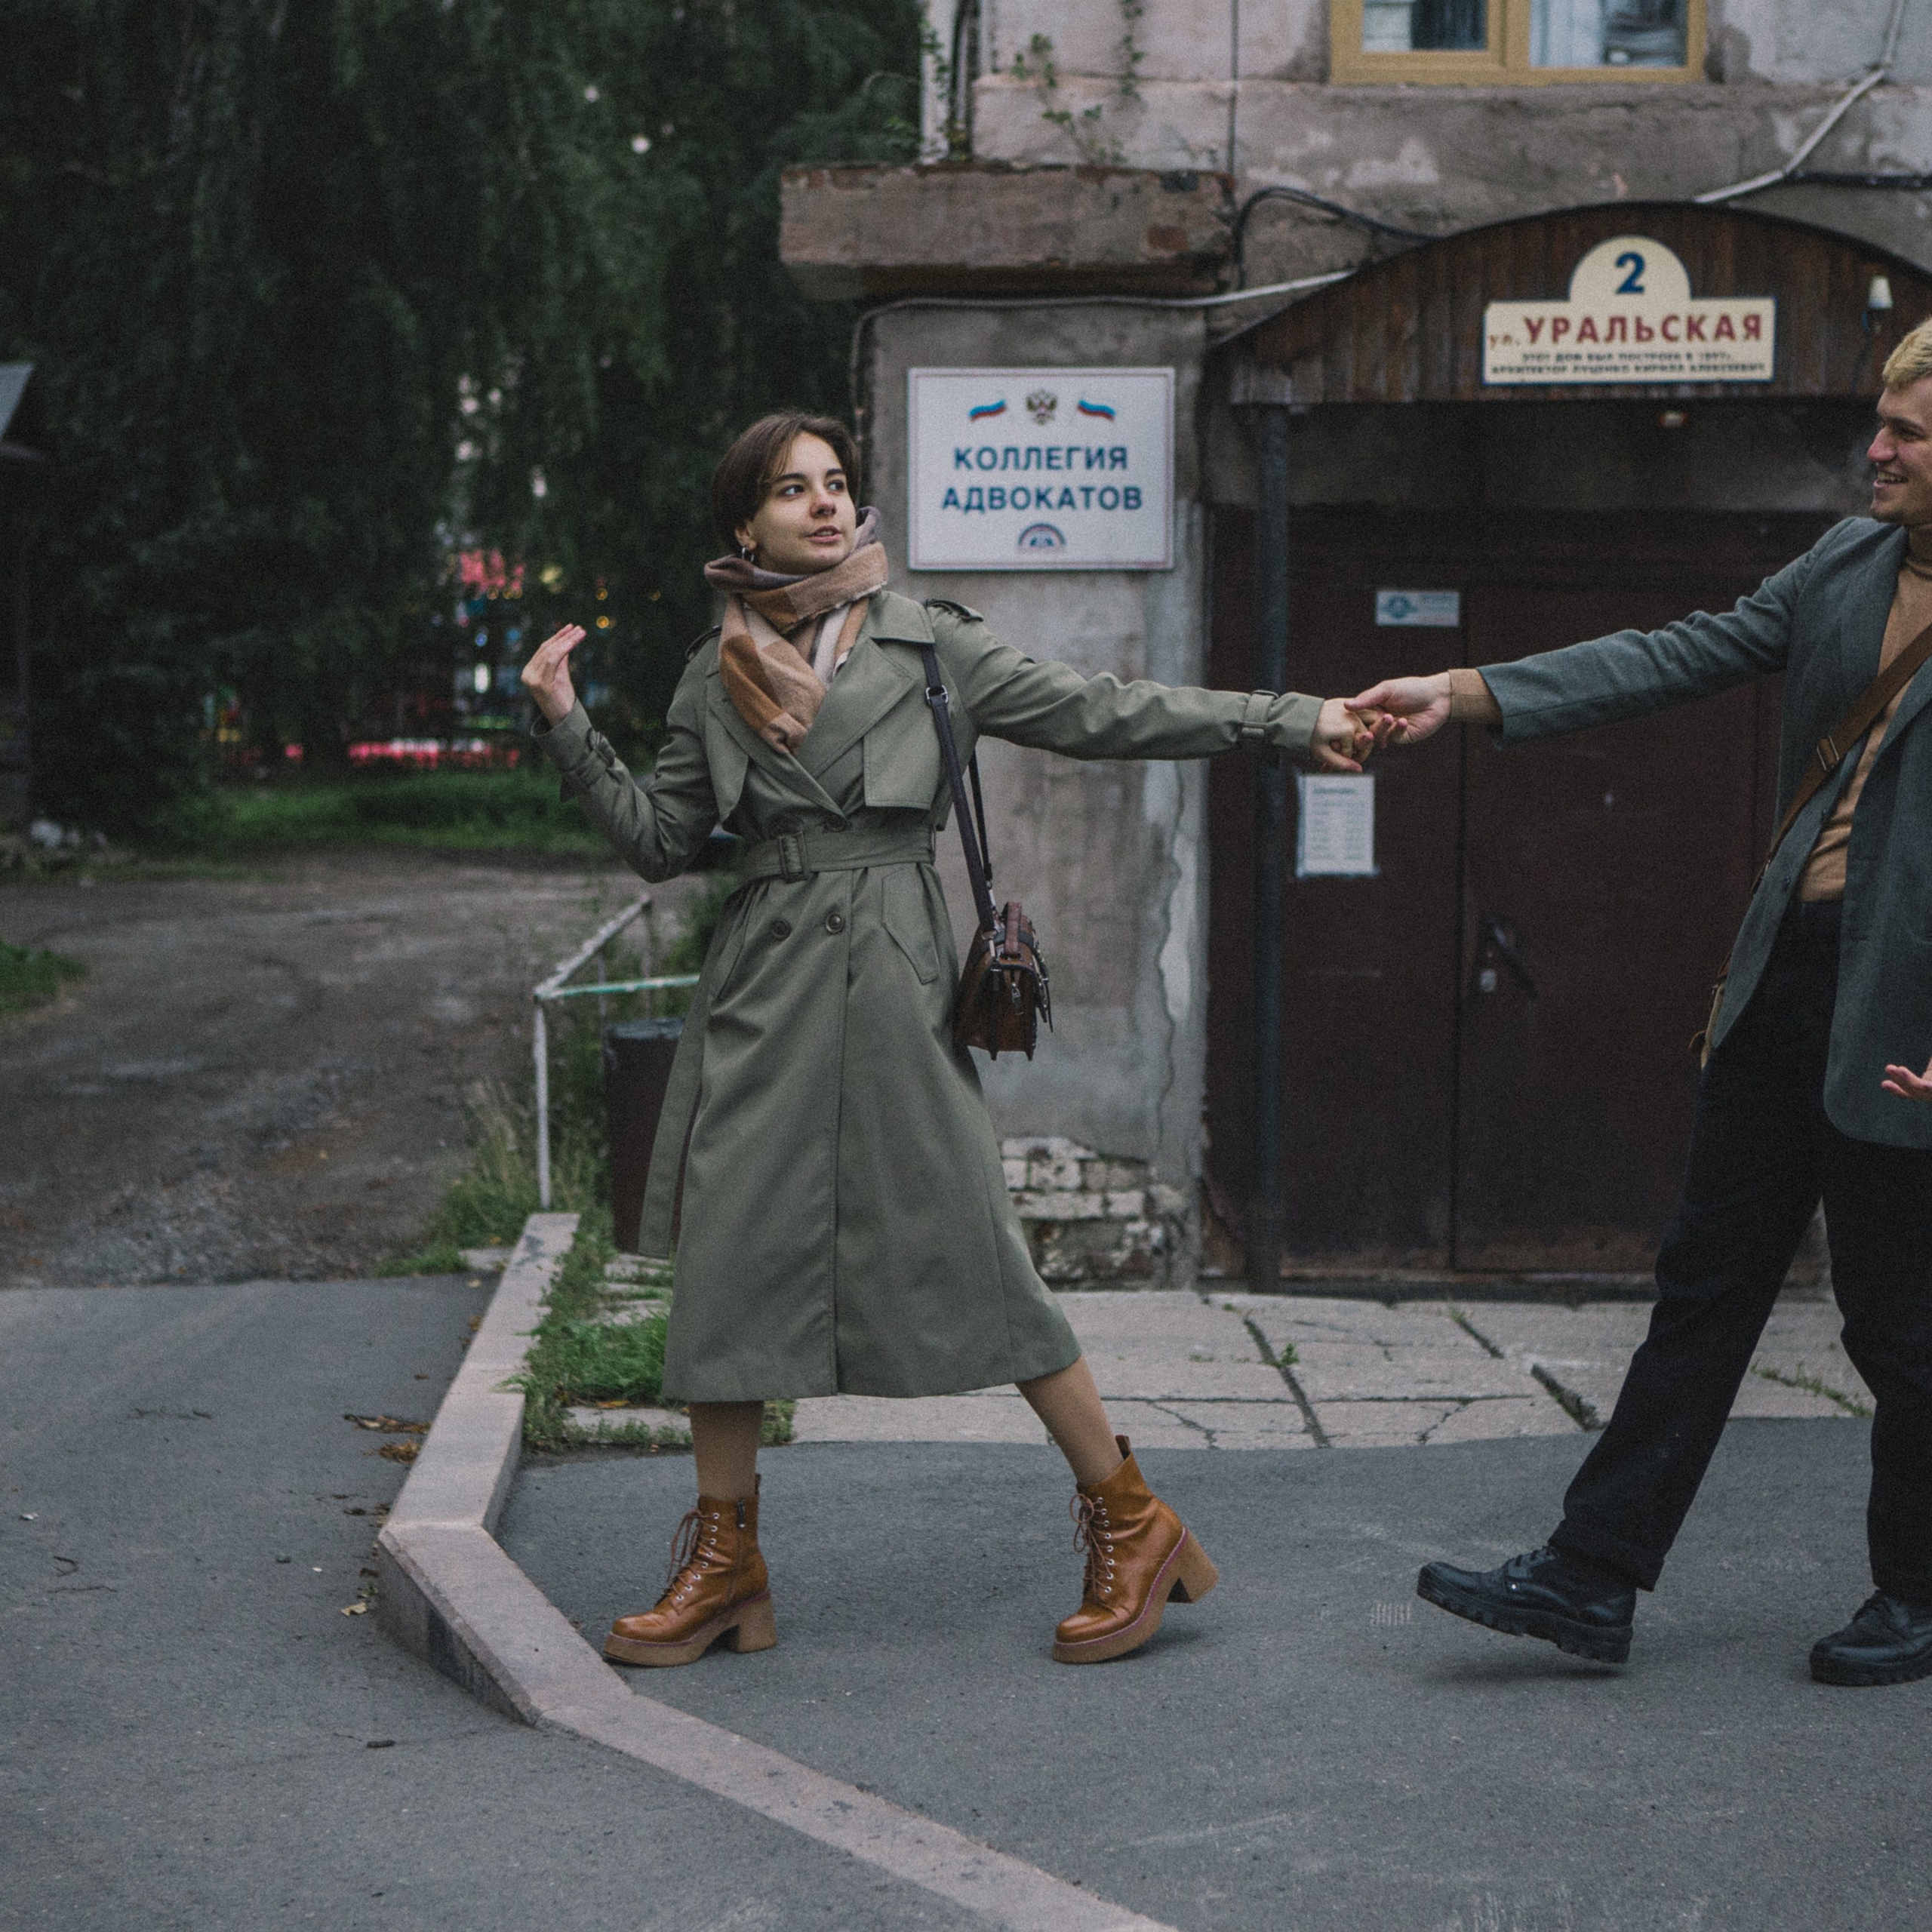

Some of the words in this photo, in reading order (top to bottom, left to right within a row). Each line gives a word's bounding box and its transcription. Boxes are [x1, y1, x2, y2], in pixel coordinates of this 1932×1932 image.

[1615, 251, 1645, 294] 2
[1524, 314, 1761, 344] УРАЛЬСКАЯ
[954, 446, 1128, 471] КОЛЛЕГИЯ
[942, 486, 1143, 514] АДВОКАТОВ
